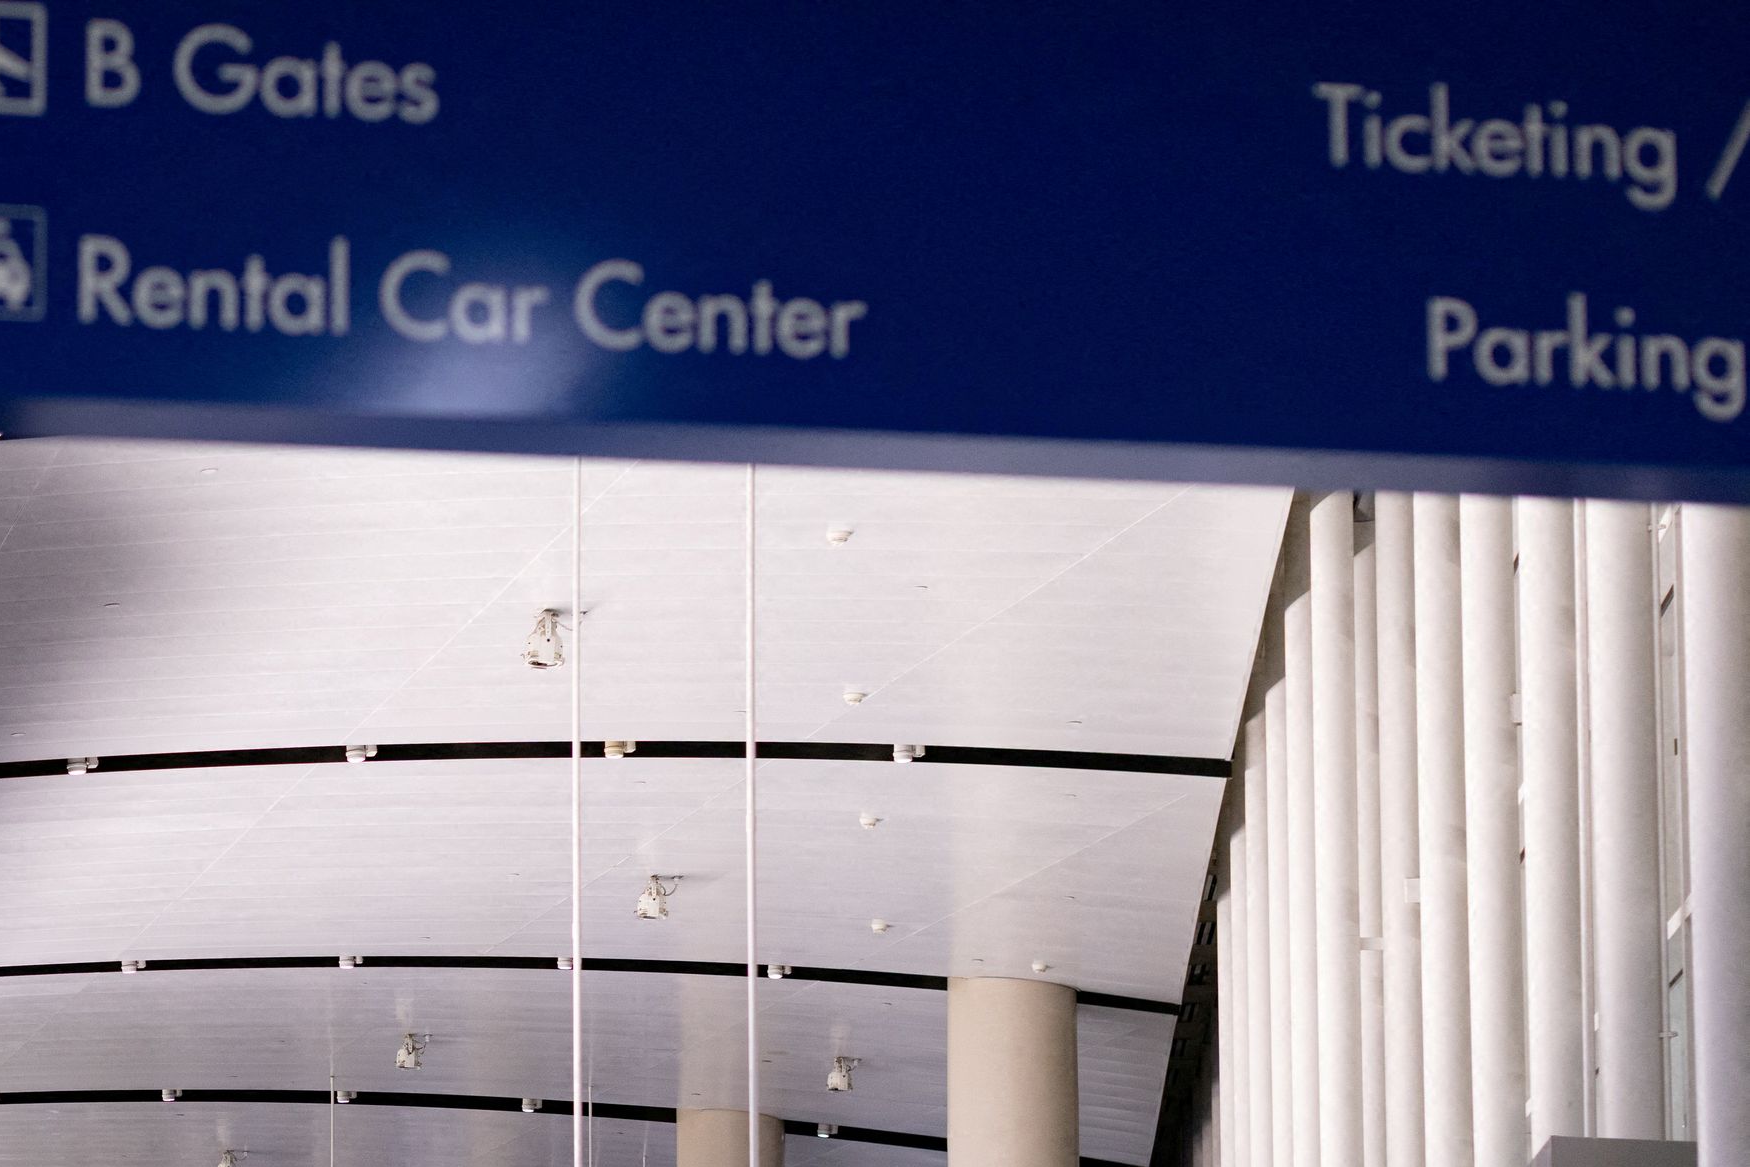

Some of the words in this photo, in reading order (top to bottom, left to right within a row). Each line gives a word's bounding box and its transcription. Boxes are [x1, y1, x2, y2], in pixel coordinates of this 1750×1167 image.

[84, 18, 141, 108] B
[172, 22, 441, 124] Gates
[1311, 81, 1678, 212] Ticketing
[77, 236, 352, 338] Rental
[378, 249, 550, 344] Car
[572, 258, 868, 361] Center
[1424, 291, 1748, 423] Parking
